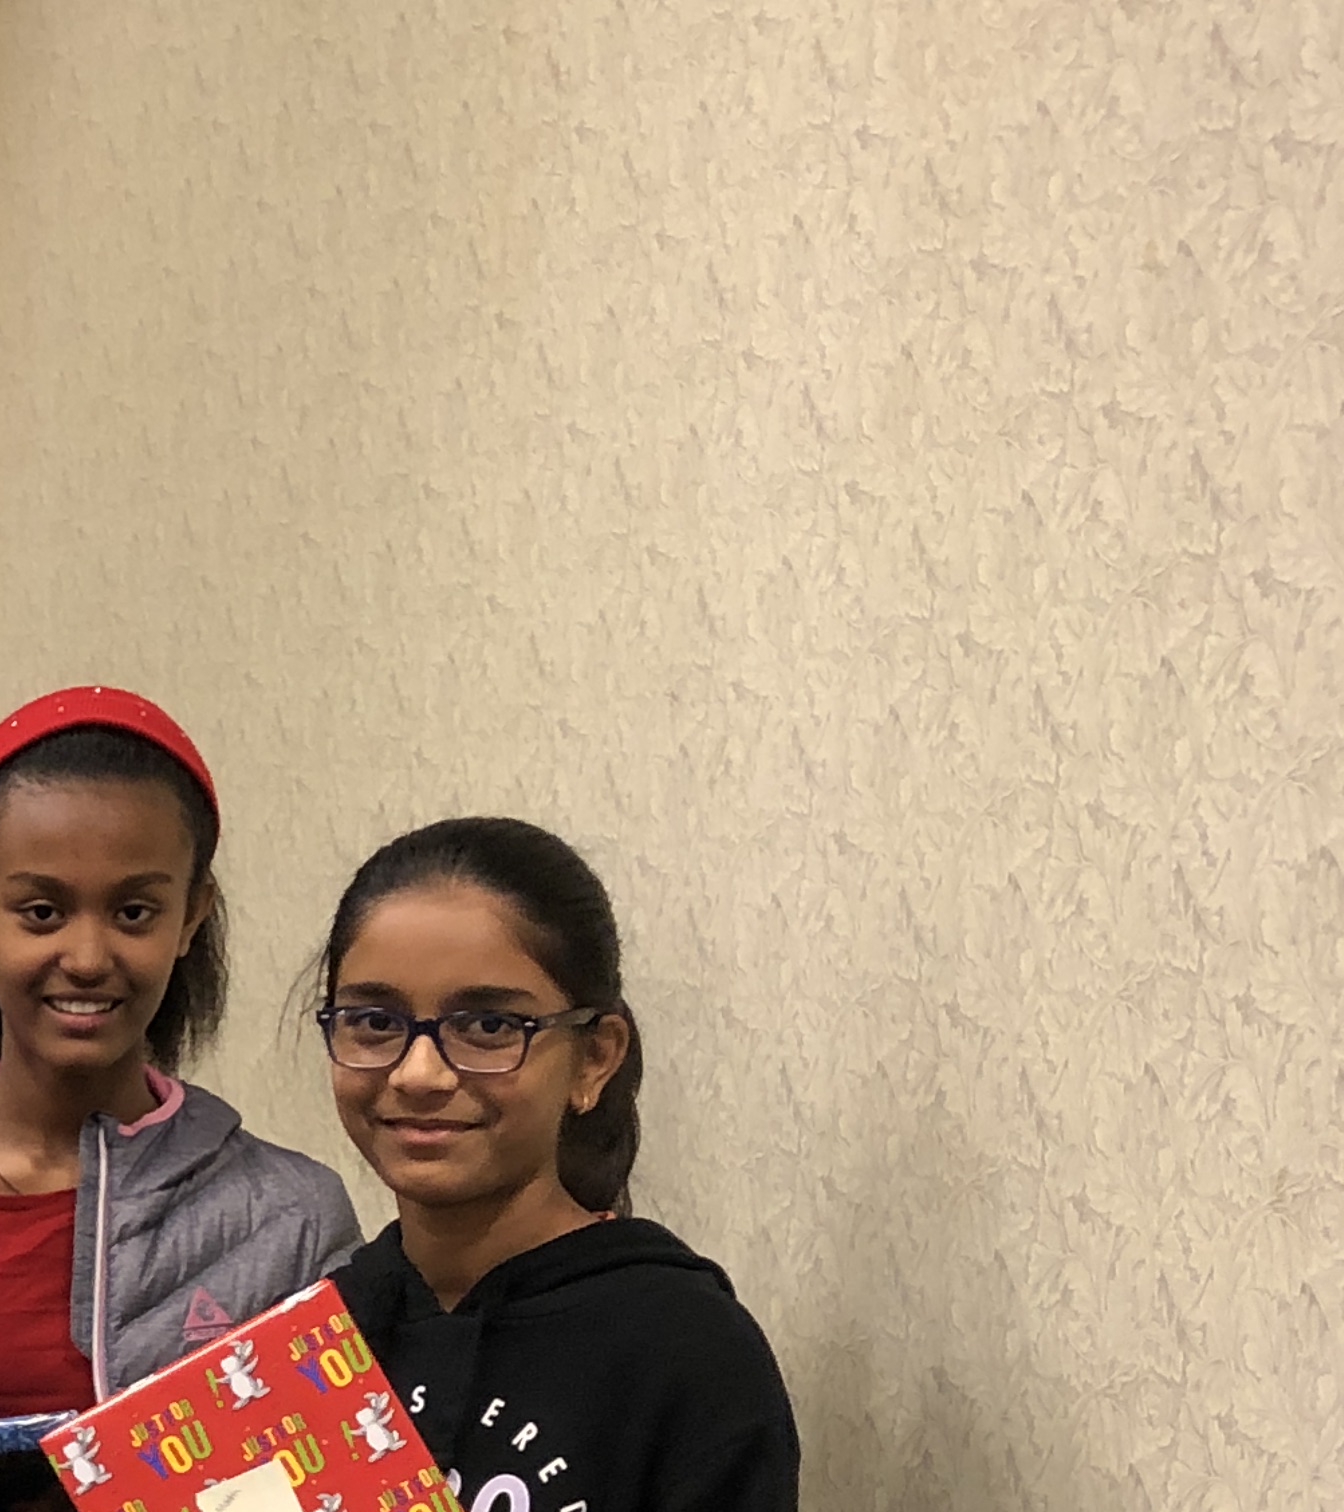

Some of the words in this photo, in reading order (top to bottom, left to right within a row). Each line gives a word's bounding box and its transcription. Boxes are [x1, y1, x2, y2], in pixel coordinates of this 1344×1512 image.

[288, 1326, 324, 1362] JUST
[296, 1332, 373, 1394] YOU
[129, 1413, 165, 1448] JUST
[241, 1427, 278, 1462] JUST
[136, 1419, 212, 1480] YOU
